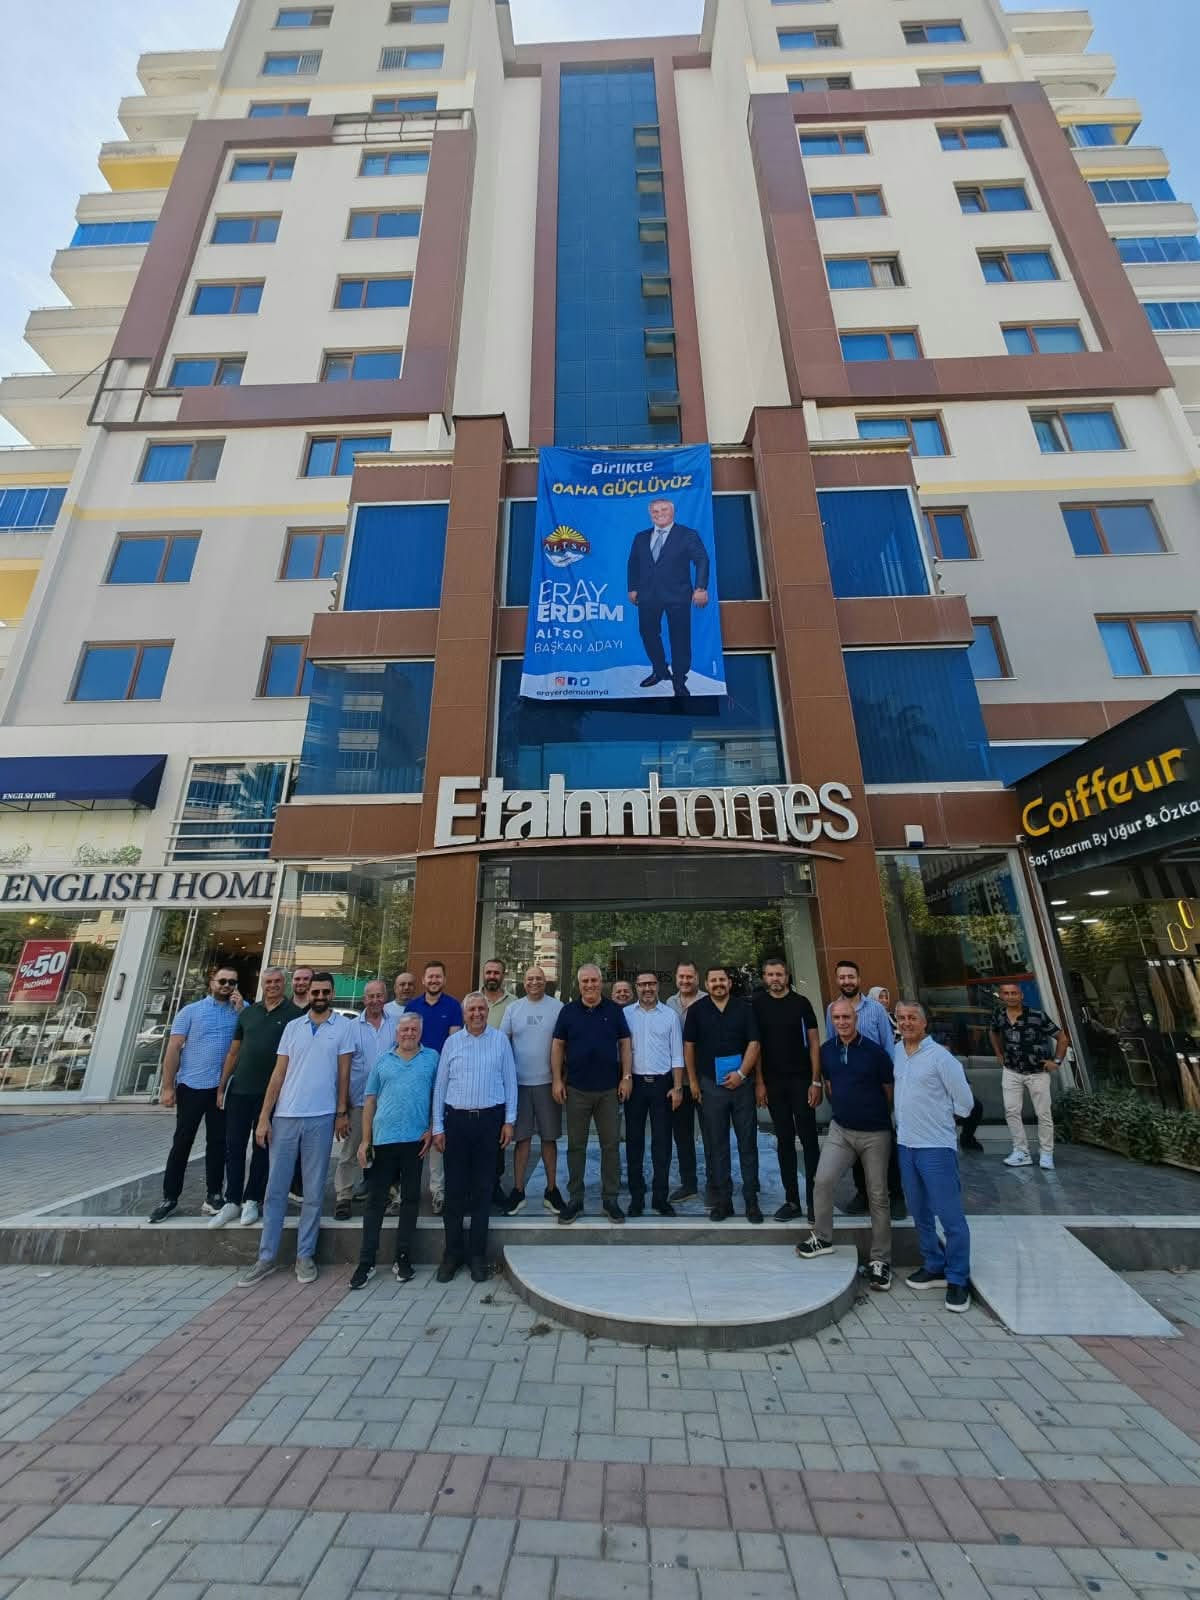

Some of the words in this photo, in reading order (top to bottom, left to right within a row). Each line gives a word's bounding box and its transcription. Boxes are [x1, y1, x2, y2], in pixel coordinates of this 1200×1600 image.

[592, 461, 653, 475] Birlikte
[552, 483, 598, 496] DAHA
[602, 475, 692, 497] GÜÇLÜYÜZ
[543, 541, 587, 553] ALTSO
[538, 579, 608, 604] ERAY
[537, 601, 624, 622] ERDEM
[535, 627, 583, 639] ALTSO
[534, 640, 582, 654] BAŞKAN
[587, 640, 623, 653] ADAYI
[1022, 748, 1184, 837] Coiffeur
[1029, 854, 1049, 867] Saç
[1048, 838, 1093, 861] Tasarım
[1092, 832, 1108, 847] By
[1108, 819, 1143, 840] Uğur
[1144, 814, 1159, 828] &
[0, 872, 162, 902] ENGLISH
[20, 951, 67, 978] %50
